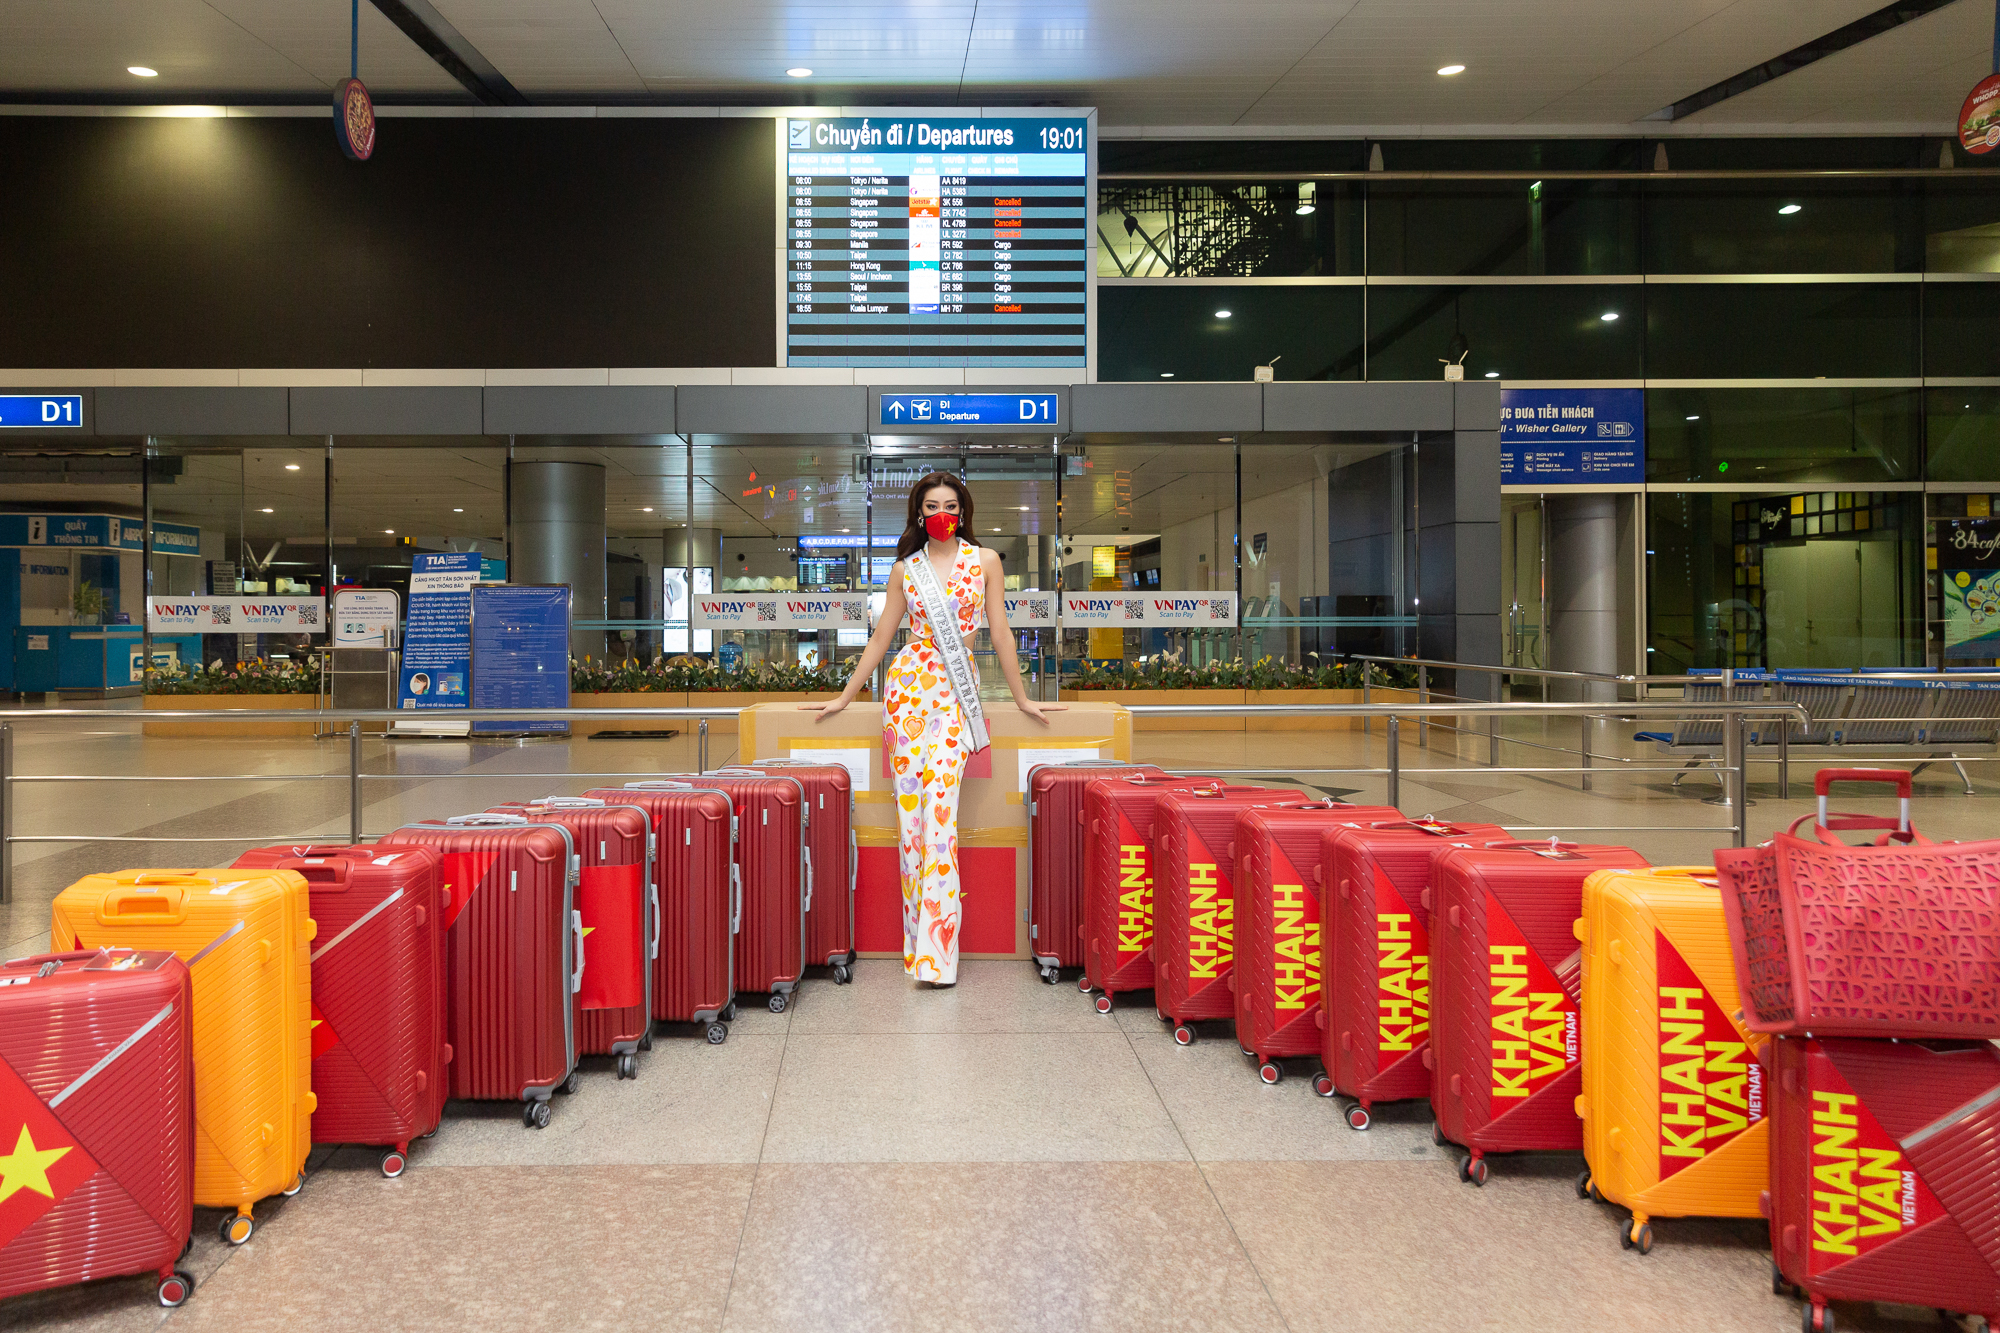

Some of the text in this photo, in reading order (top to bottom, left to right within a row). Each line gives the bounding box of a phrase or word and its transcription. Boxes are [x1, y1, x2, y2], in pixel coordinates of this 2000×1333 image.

[1972, 90, 1998, 104] WHOPP
[816, 119, 1083, 150] Chuyến đi / Departures 19:01
[850, 177, 867, 186] Tokyo
[850, 188, 867, 197] Tokyo
[850, 198, 878, 207] Singapore
[850, 209, 878, 218] Singapore
[850, 220, 878, 228] Singapore
[850, 230, 878, 239] Singapore
[994, 241, 1011, 250] Cargo
[850, 251, 867, 260] Taipei
[994, 251, 1011, 260] Cargo
[850, 262, 865, 271] Hong
[866, 262, 880, 271] Kong
[994, 262, 1011, 271] Cargo
[994, 273, 1011, 282] Cargo
[850, 283, 867, 292] Taipei
[994, 283, 1011, 292] Cargo
[850, 294, 867, 303] Taipei
[994, 294, 1011, 303] Cargo
[867, 305, 888, 314] Lumpur
[42, 401, 73, 422] D1
[940, 412, 979, 421] Departure
[1020, 400, 1048, 419] D1
[1500, 404, 1594, 421] ỰC ĐƯA TIỄN KHÁCH
[1516, 424, 1587, 434] Wisher Gallery
[54, 534, 98, 543] THÔNG TIN
[155, 531, 197, 547] INFORMATION
[426, 556, 446, 565] TIA
[913, 561, 980, 718] MISS UNIVERSE VIETNAM
[1118, 845, 1145, 951] KHANH
[1189, 863, 1217, 978] KHANH
[1273, 884, 1305, 1009] KHANH
[1378, 913, 1412, 1051] KHANH
[1489, 945, 1530, 1096] KHANH
[1529, 992, 1566, 1079] VAN
[1565, 1012, 1577, 1063] VIETNAM
[1659, 987, 1705, 1158] KHANH
[1705, 1041, 1748, 1138] VAN
[1749, 1064, 1762, 1122] VIETNAM
[1812, 1090, 1858, 1255] KHANH
[1859, 1148, 1901, 1237] VAN
[1901, 1170, 1915, 1226] VIETNAM
